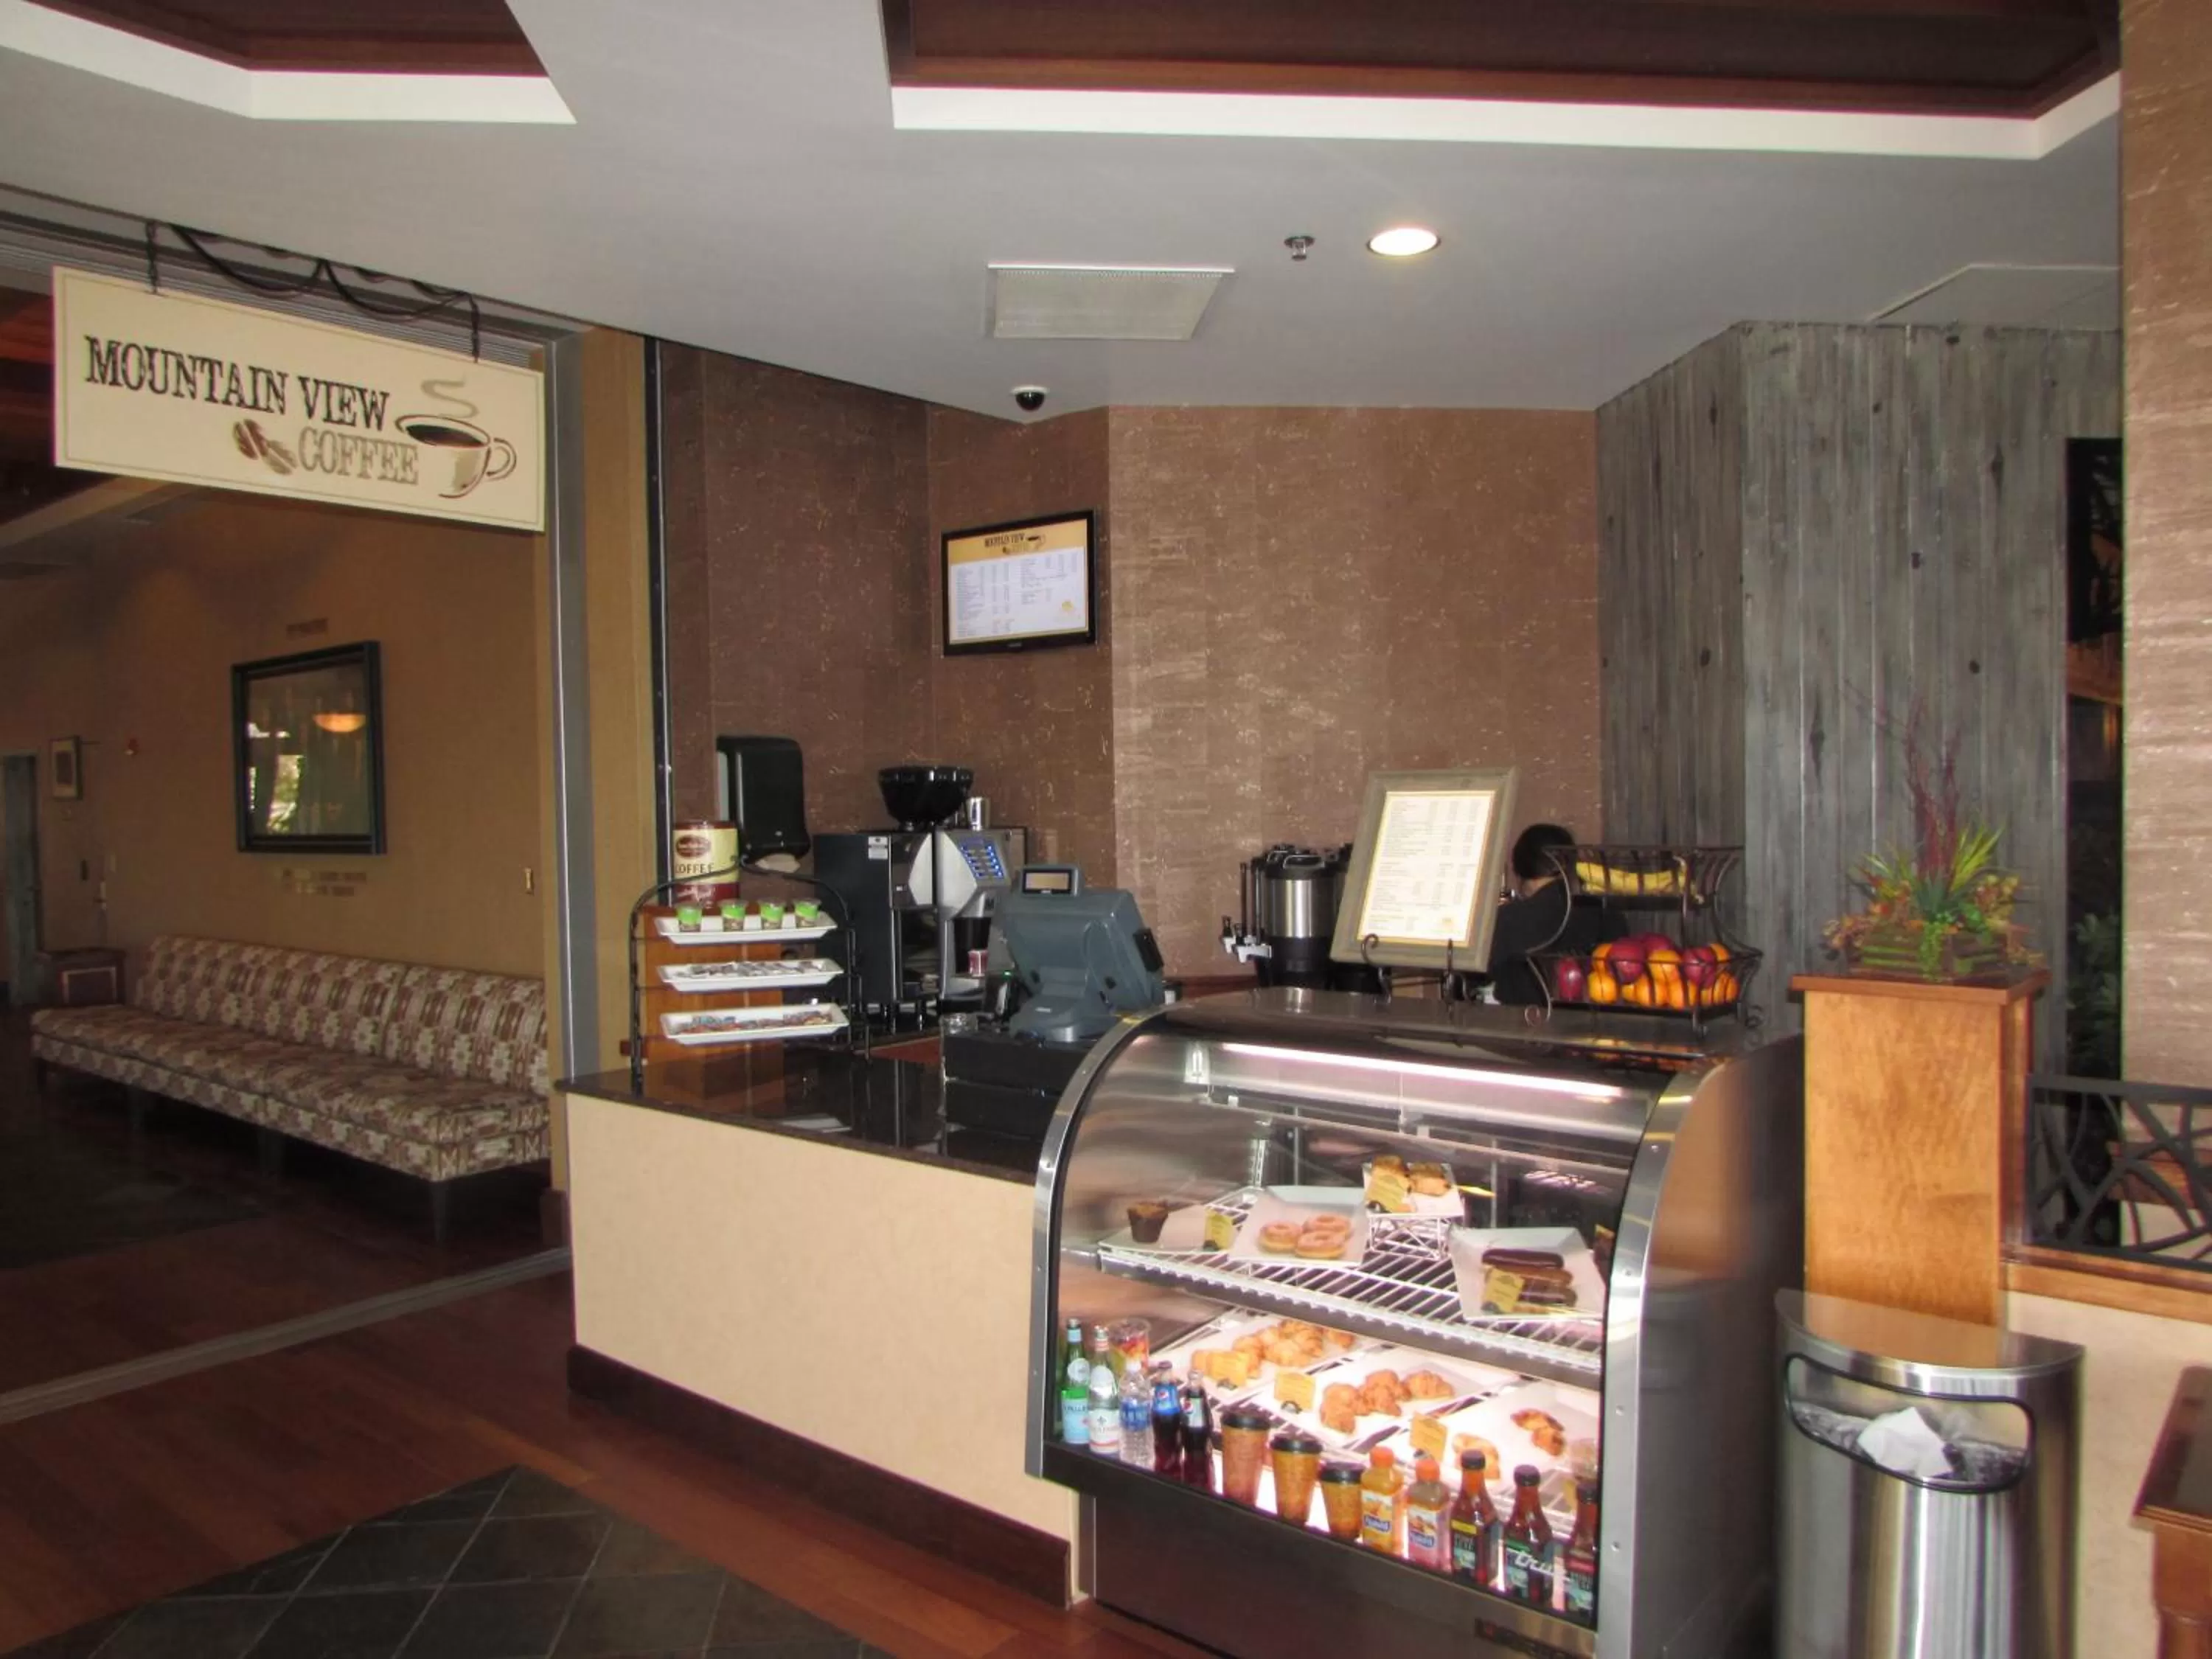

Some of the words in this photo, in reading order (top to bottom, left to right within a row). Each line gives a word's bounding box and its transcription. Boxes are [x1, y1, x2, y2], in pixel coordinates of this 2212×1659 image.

[84, 335, 288, 414] MOUNTAIN
[297, 376, 390, 431] VIEW
[298, 426, 420, 485] COFFEE
